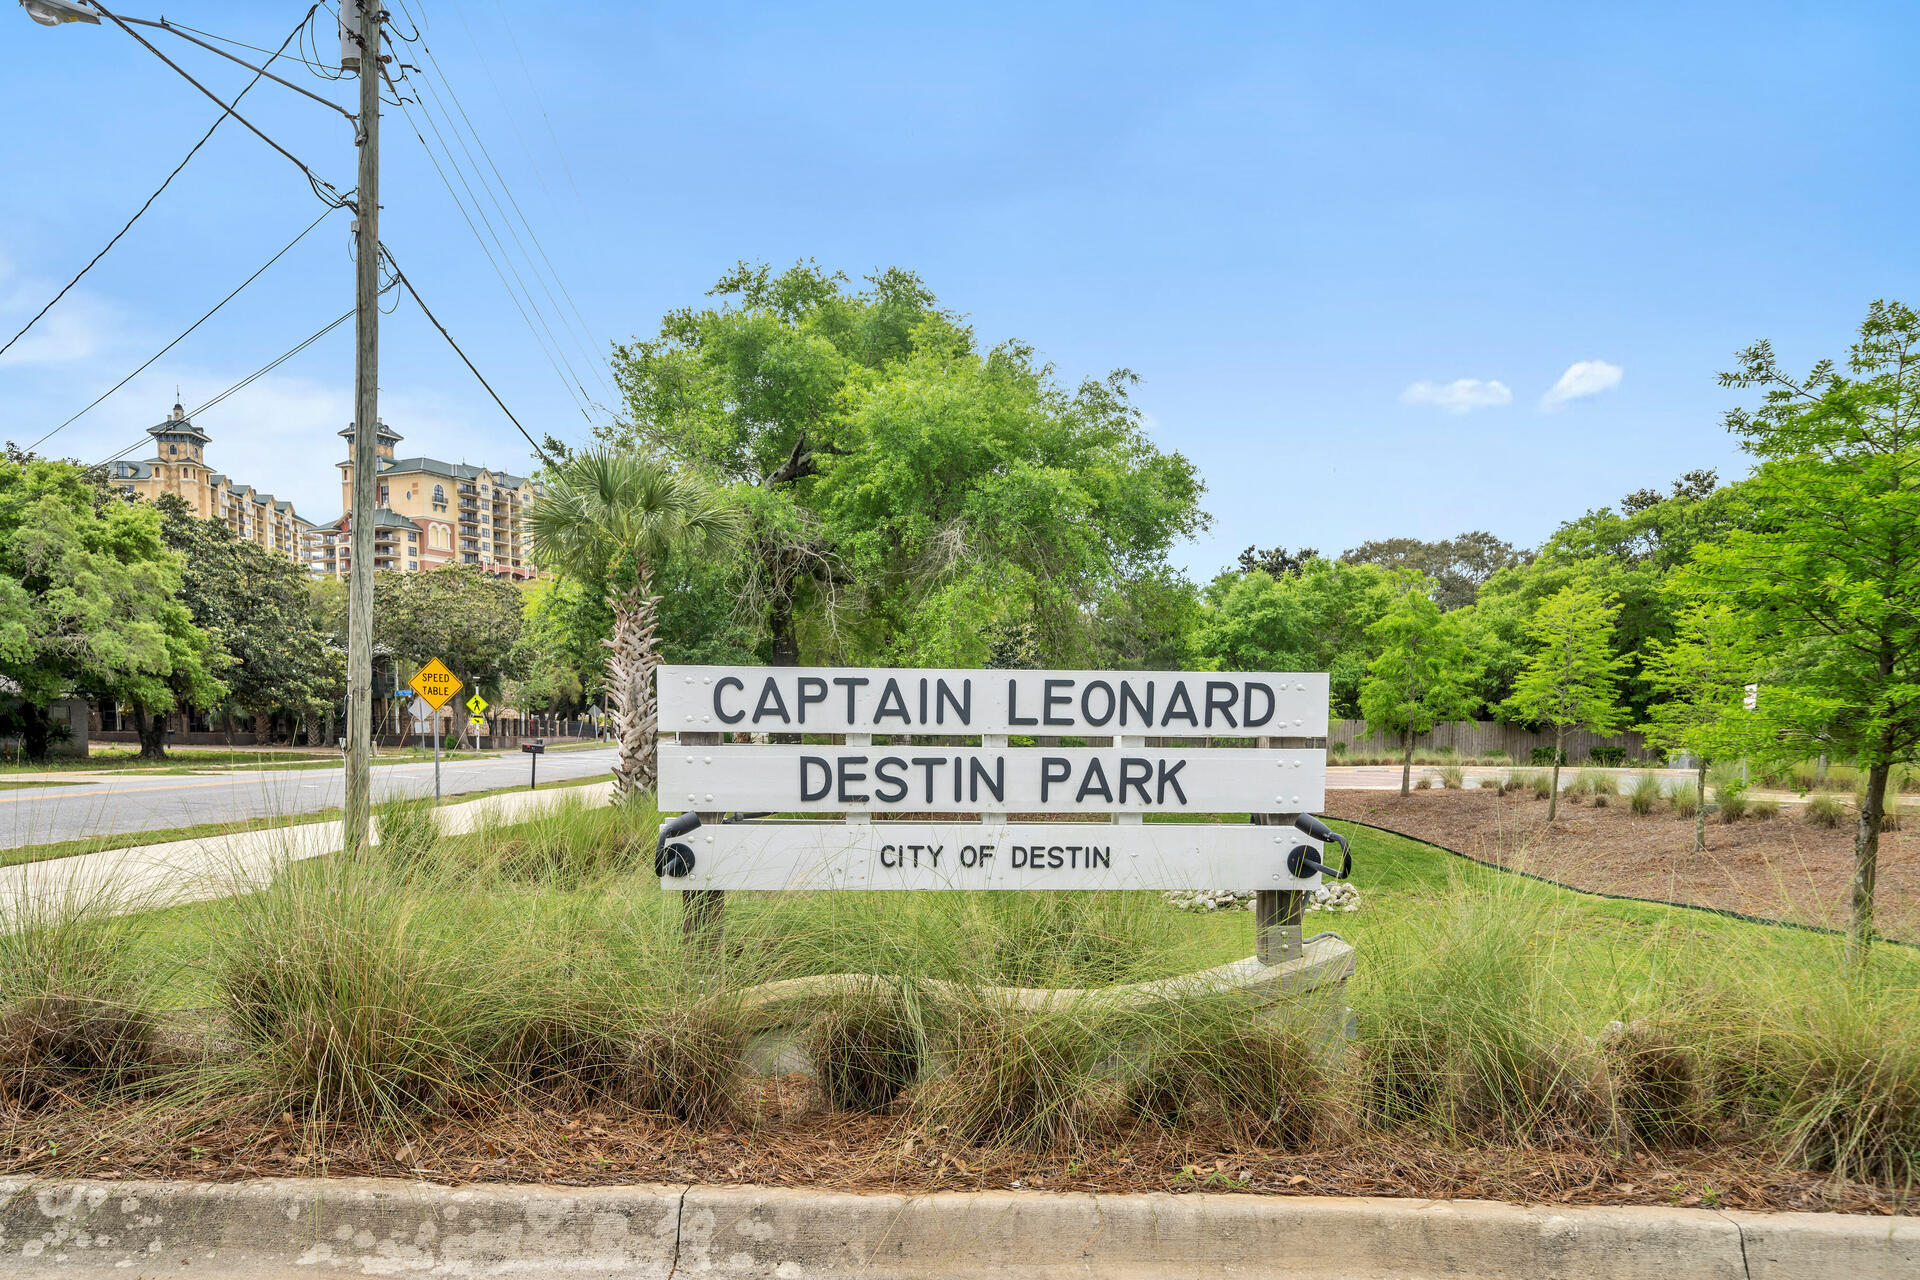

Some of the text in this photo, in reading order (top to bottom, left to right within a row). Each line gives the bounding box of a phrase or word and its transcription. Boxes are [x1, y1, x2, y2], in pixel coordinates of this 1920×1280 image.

[422, 673, 450, 683] SPEED
[423, 686, 449, 696] TABLE
[714, 677, 1275, 728] CAPTAIN LEONARD
[800, 756, 1187, 805] DESTIN PARK
[880, 845, 1110, 869] CITY OF DESTIN
